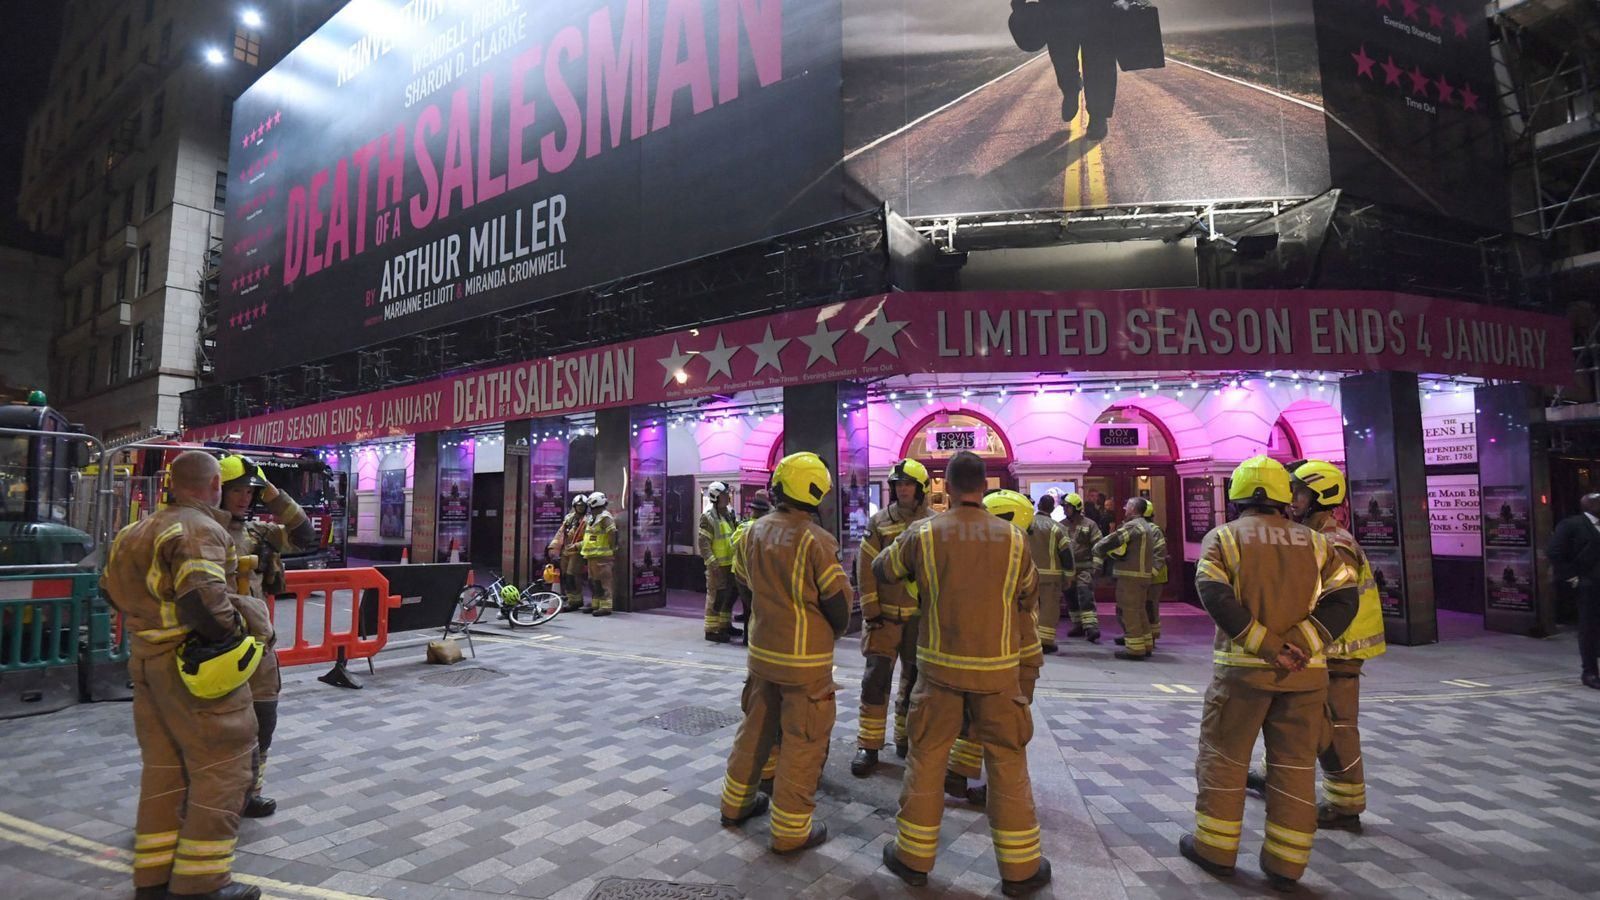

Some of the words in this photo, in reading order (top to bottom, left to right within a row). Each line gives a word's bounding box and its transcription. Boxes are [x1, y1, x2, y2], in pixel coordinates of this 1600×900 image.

[1383, 15, 1410, 34] Evening
[1411, 26, 1442, 44] Standard
[404, 61, 452, 109] SHARON
[456, 56, 467, 79] D.
[472, 12, 528, 67] CLARKE
[411, 20, 468, 75] WENDELL
[1405, 96, 1422, 110] Time
[1423, 102, 1436, 114] Out
[283, 122, 404, 287] DEATH
[375, 212, 390, 246] OF
[392, 207, 400, 238] A
[409, 0, 783, 229] SALESMAN
[365, 288, 376, 307] BY
[379, 233, 461, 302] ARTHUR
[469, 193, 567, 272] MILLER
[384, 294, 422, 321] MARIANNE
[423, 284, 455, 309] ELLIOTT
[465, 269, 507, 297] MIRANDA
[509, 249, 567, 284] CROMWELL
[937, 309, 1108, 357] LIMITED
[1127, 307, 1292, 355] SEASON
[1308, 308, 1405, 356] ENDS
[1416, 313, 1433, 358] 4
[1442, 316, 1547, 370] JANUARY
[453, 370, 511, 424] DEATH
[513, 347, 635, 415] SALESMAN
[828, 369, 857, 378] Standard
[863, 366, 878, 374] Time
[249, 419, 284, 445] LIMITED
[287, 411, 327, 442] SEASON
[331, 405, 362, 436] ENDS
[366, 403, 374, 428] 4
[378, 391, 442, 428] JANUARY
[1423, 426, 1456, 437] EENS
[1461, 421, 1475, 434] H
[941, 432, 968, 440] ROYAL
[1109, 429, 1128, 437] BOX
[254, 460, 298, 469] don-fire.gov.uk
[941, 521, 1005, 542] FIRE
[1241, 527, 1308, 546] FIRE
